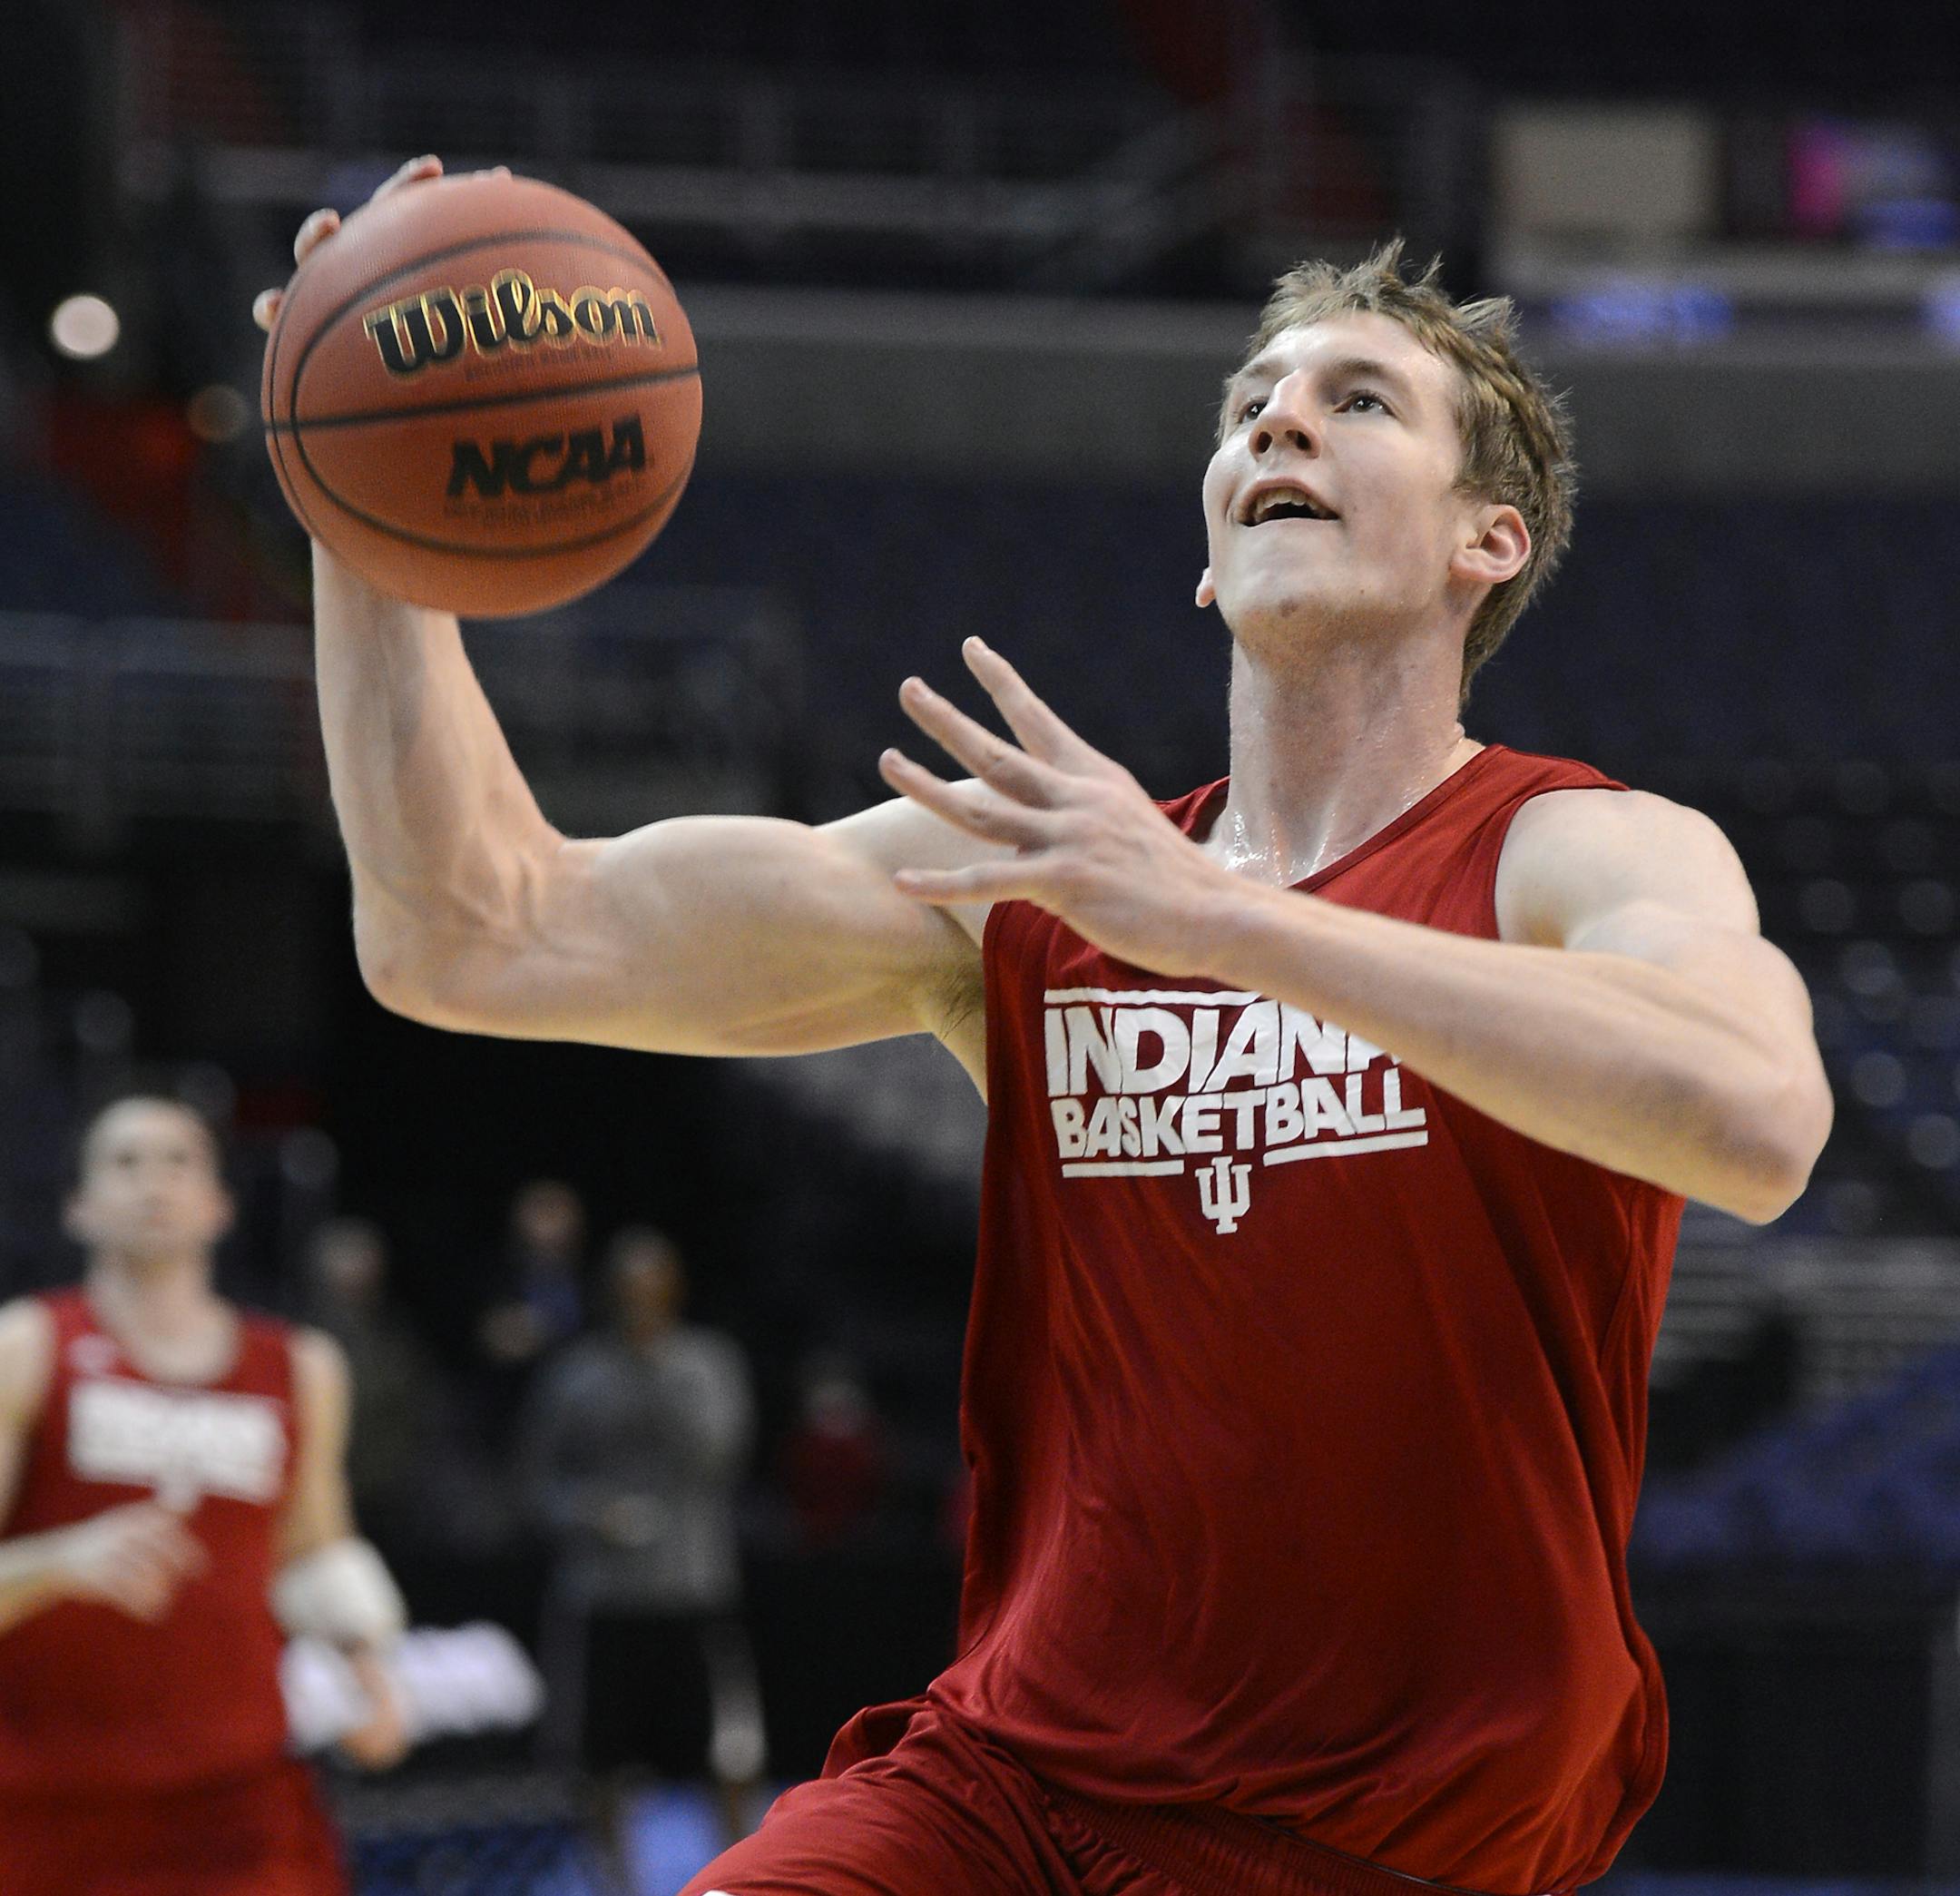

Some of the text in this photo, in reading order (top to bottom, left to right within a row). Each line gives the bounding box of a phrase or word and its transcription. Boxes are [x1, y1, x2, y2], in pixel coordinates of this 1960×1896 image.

[362, 267, 662, 381] Wilson
[446, 413, 647, 496] NCAA
[1050, 1067, 1427, 1159] BASKETBALL
